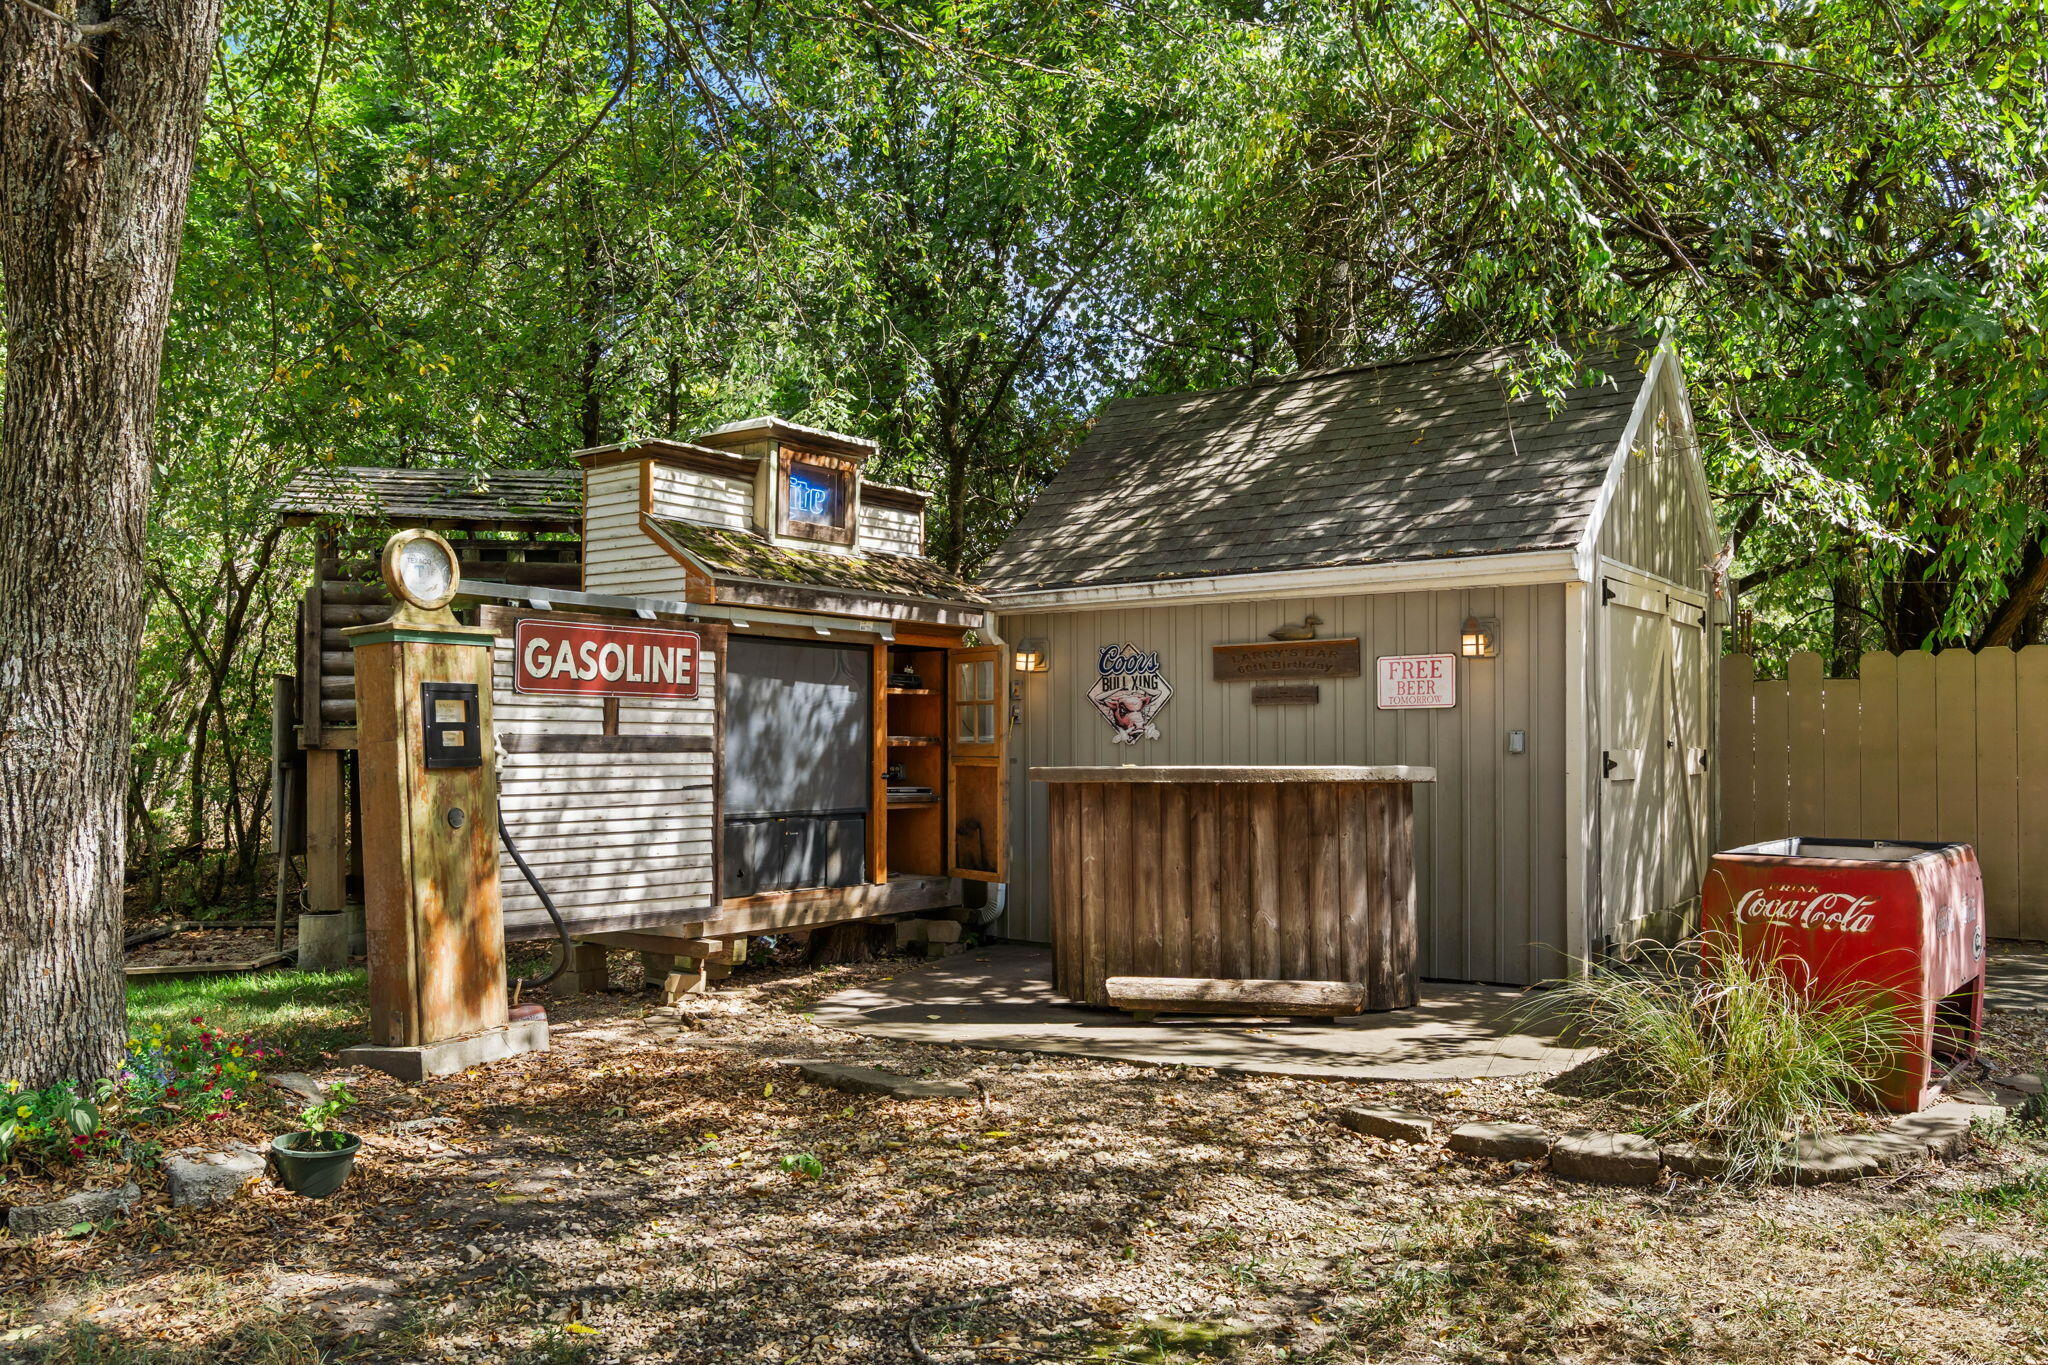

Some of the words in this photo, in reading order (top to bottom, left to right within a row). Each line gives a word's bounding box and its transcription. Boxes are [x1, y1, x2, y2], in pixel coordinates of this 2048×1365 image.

[524, 637, 691, 685] GASOLINE
[1099, 645, 1159, 675] Coors
[1304, 648, 1339, 659] BAR
[1271, 660, 1335, 673] Birthday
[1388, 660, 1443, 680] FREE
[1102, 675, 1129, 692] BULL
[1131, 675, 1158, 691] XING
[1396, 680, 1436, 696] BEER
[1388, 695, 1443, 705] TOMORROW
[1736, 888, 1876, 933] Coca-Cola
